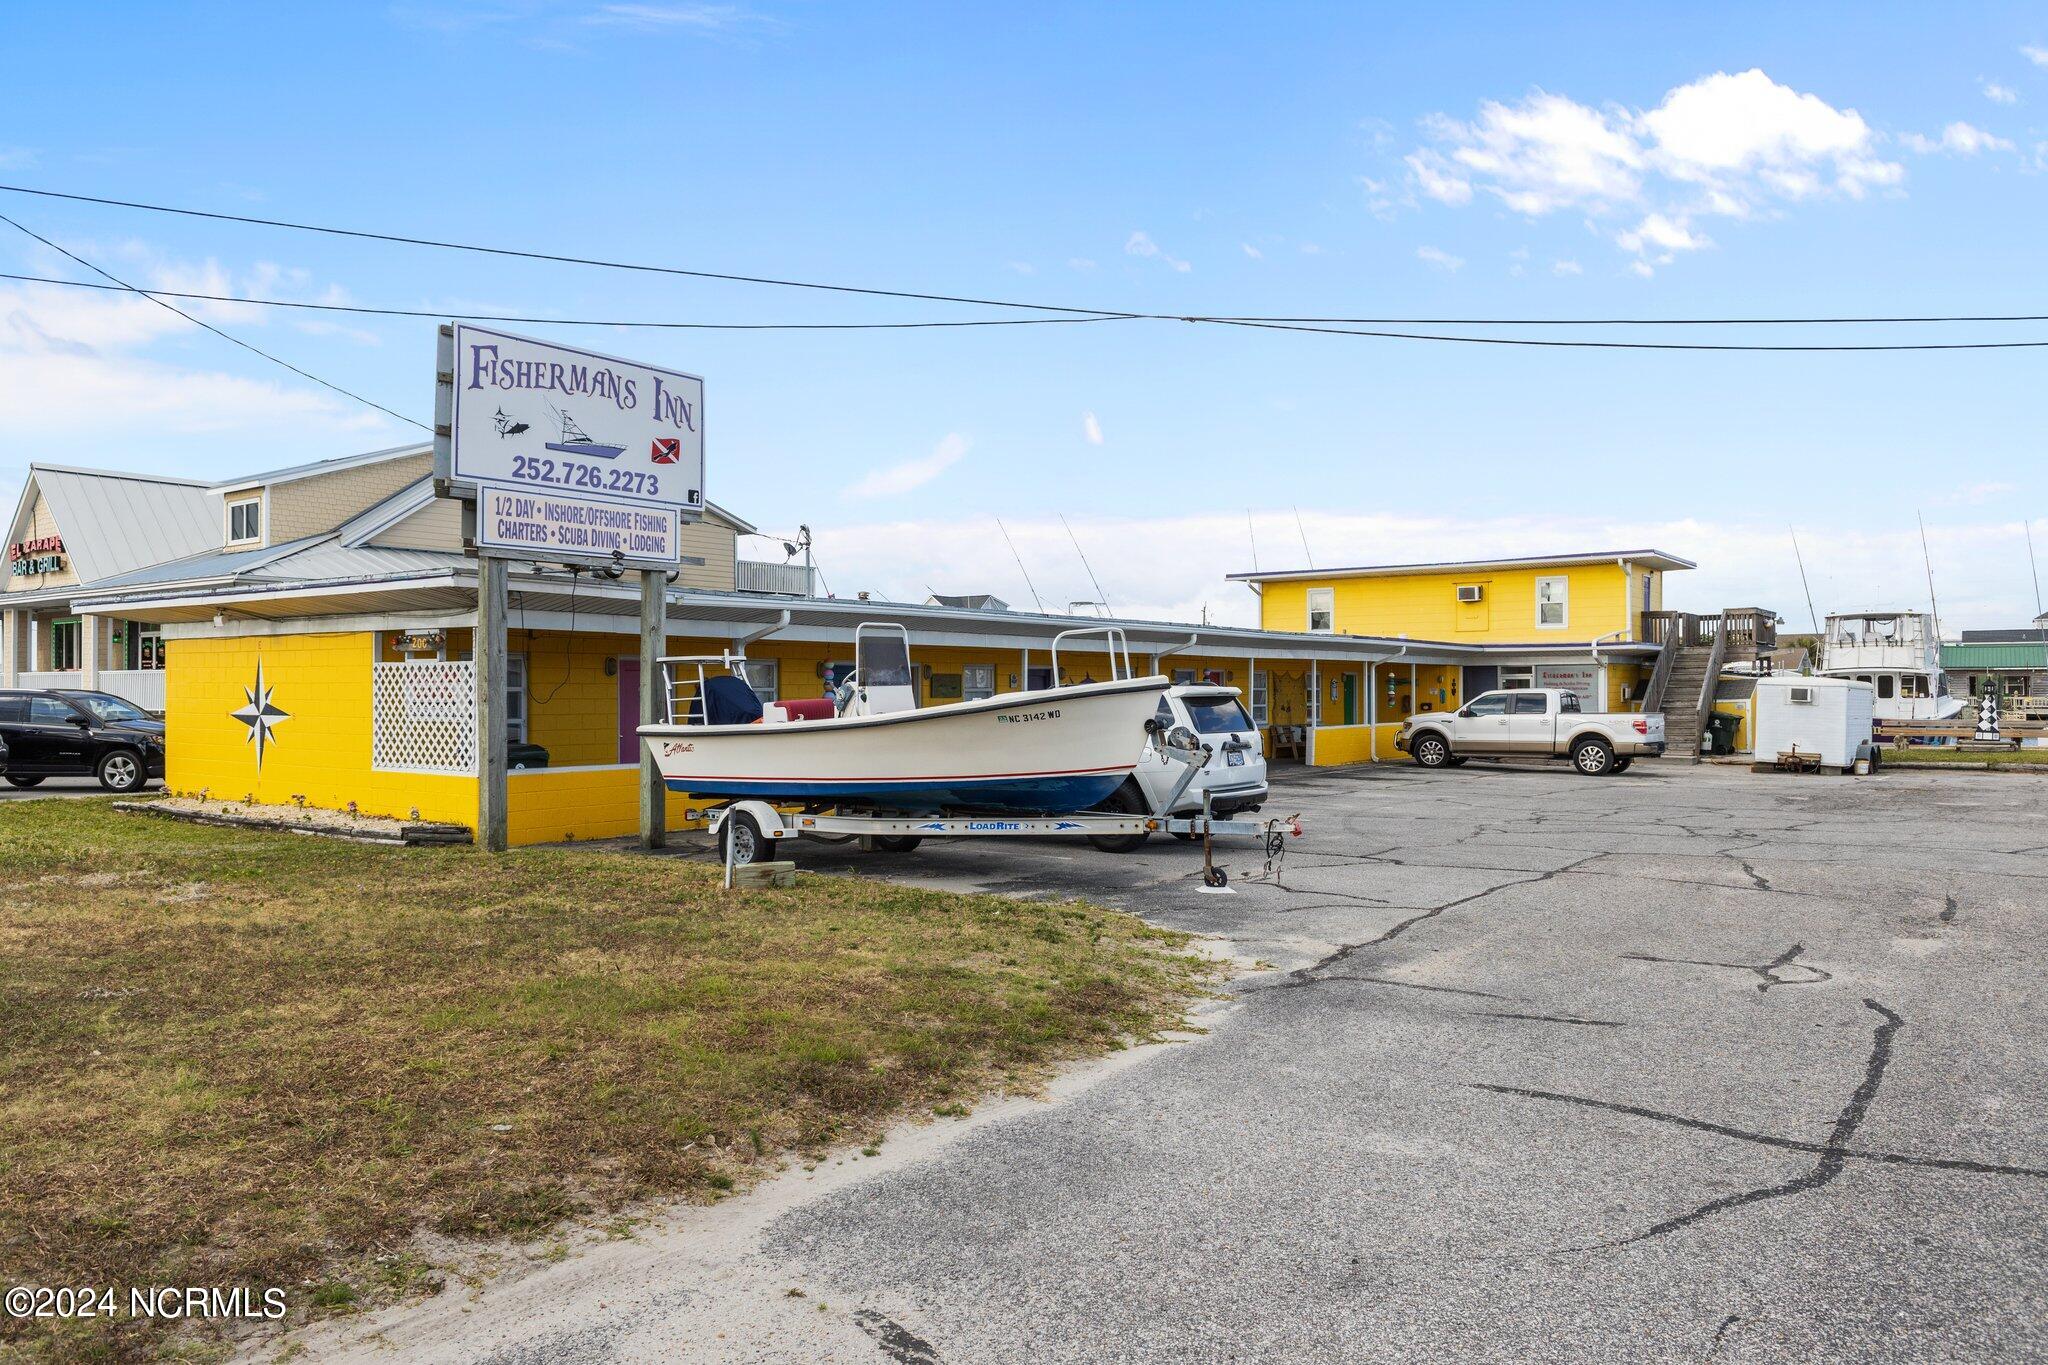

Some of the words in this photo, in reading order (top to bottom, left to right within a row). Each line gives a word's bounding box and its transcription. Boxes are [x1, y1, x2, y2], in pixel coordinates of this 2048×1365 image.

[467, 344, 638, 410] FISHERMANS
[652, 376, 696, 432] INN
[512, 455, 659, 496] 252.726.2273
[495, 496, 513, 516] 1/2
[515, 498, 535, 519] DAY
[544, 501, 632, 530] INSHORE/OFFSHORE
[634, 512, 667, 533] FISHING
[10, 543, 21, 561] EL
[24, 536, 61, 553] ZARAPE
[497, 518, 548, 543] CHARTERS
[558, 525, 588, 546] SCUBA
[591, 530, 621, 549] DIVING
[629, 532, 666, 554] LODGING
[12, 559, 27, 576] BAR
[29, 559, 34, 574] &
[38, 555, 60, 573] GRILL
[1008, 715, 1020, 723] NC
[1022, 712, 1046, 722] 3142
[969, 822, 1020, 830] LOADRITE
